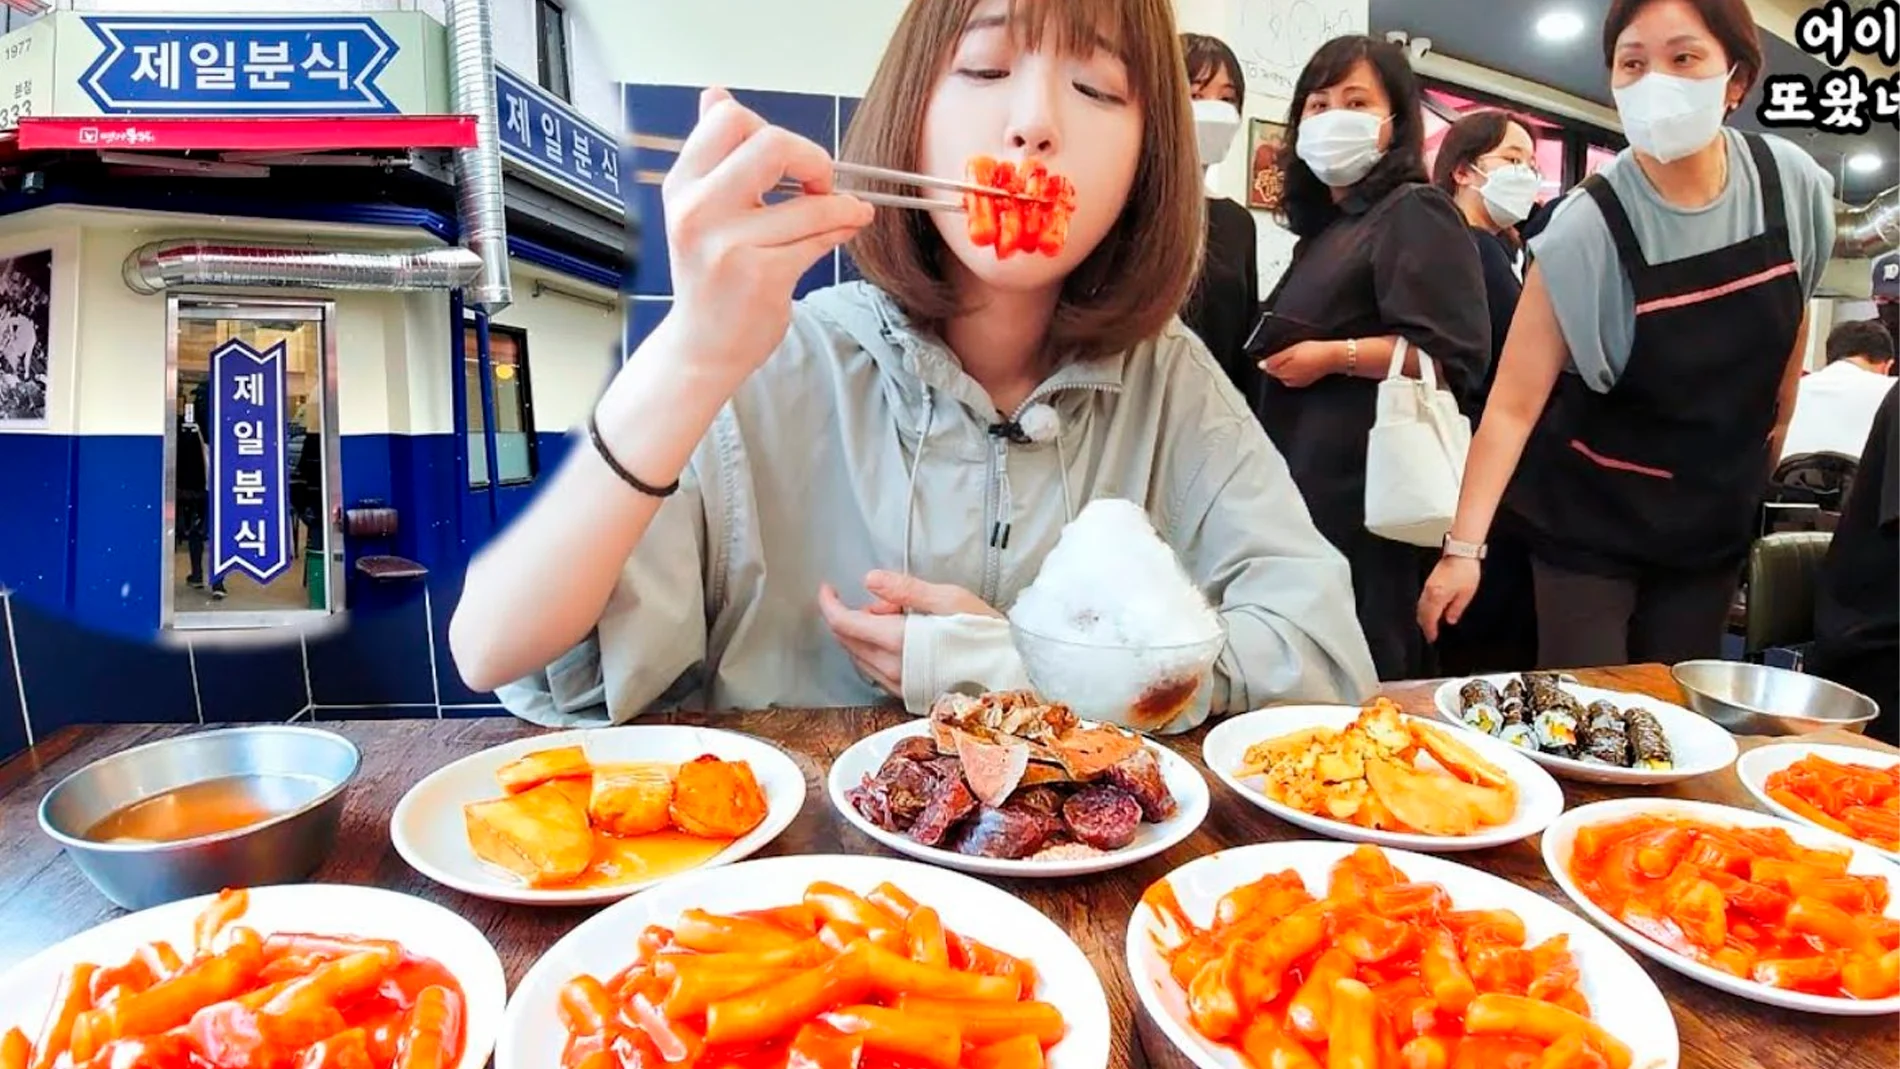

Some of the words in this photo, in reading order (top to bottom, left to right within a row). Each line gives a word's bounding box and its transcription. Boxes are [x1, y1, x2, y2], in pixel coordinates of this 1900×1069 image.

[5, 38, 32, 60] 1977
[130, 40, 350, 91] 제일분식
[505, 92, 620, 195] 제일분식
[232, 372, 267, 557] 제일분식
